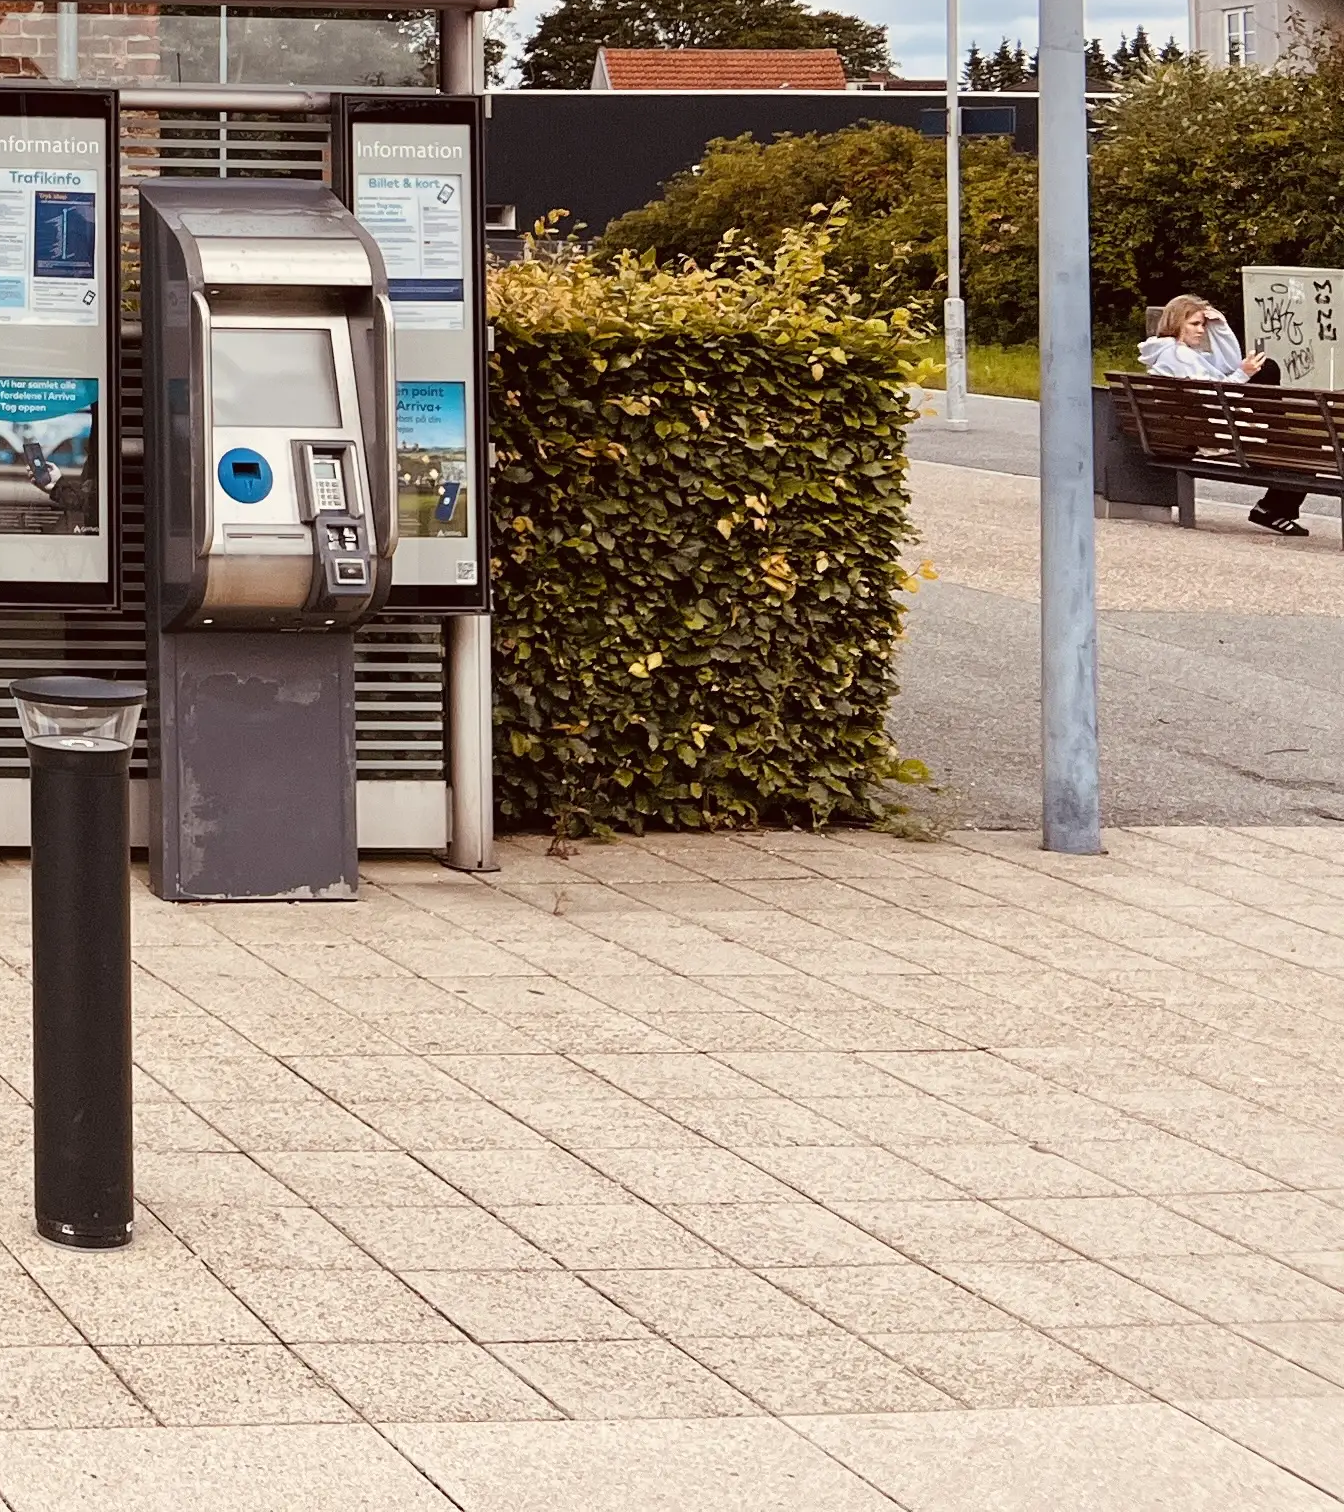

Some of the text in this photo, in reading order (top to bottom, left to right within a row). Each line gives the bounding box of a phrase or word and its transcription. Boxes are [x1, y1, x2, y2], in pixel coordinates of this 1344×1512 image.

[356, 140, 463, 159] Information
[9, 170, 82, 186] Trafikinfo
[368, 177, 442, 189] Billet & kort
[0, 379, 77, 389] Vi har samlet alle
[0, 390, 43, 401] fordelene
[47, 391, 76, 401] Arriva
[411, 385, 445, 399] point
[0, 402, 47, 413] Tog appen
[395, 400, 443, 412] Arriva+
